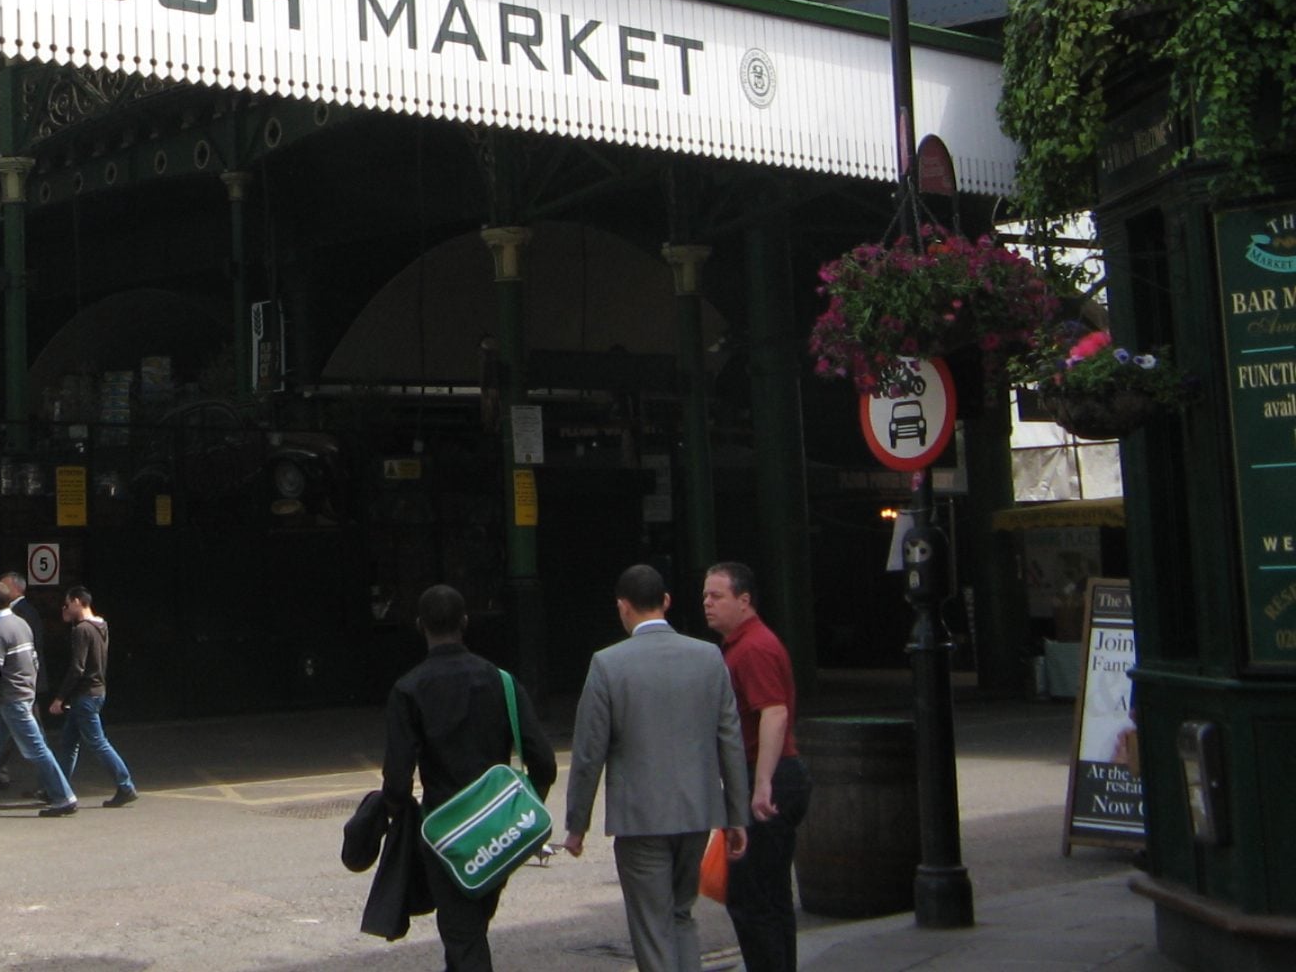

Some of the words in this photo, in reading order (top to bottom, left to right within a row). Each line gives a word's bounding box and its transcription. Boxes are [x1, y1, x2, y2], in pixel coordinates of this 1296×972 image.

[1251, 249, 1294, 268] MARKET
[1231, 289, 1277, 314] BAR
[1238, 361, 1296, 388] FUNCTI
[39, 557, 49, 573] 5
[1098, 593, 1122, 607] The
[1095, 631, 1134, 653] Join
[1087, 764, 1105, 779] At
[1108, 766, 1130, 781] the
[1092, 794, 1134, 815] Now
[464, 827, 521, 875] adidas
